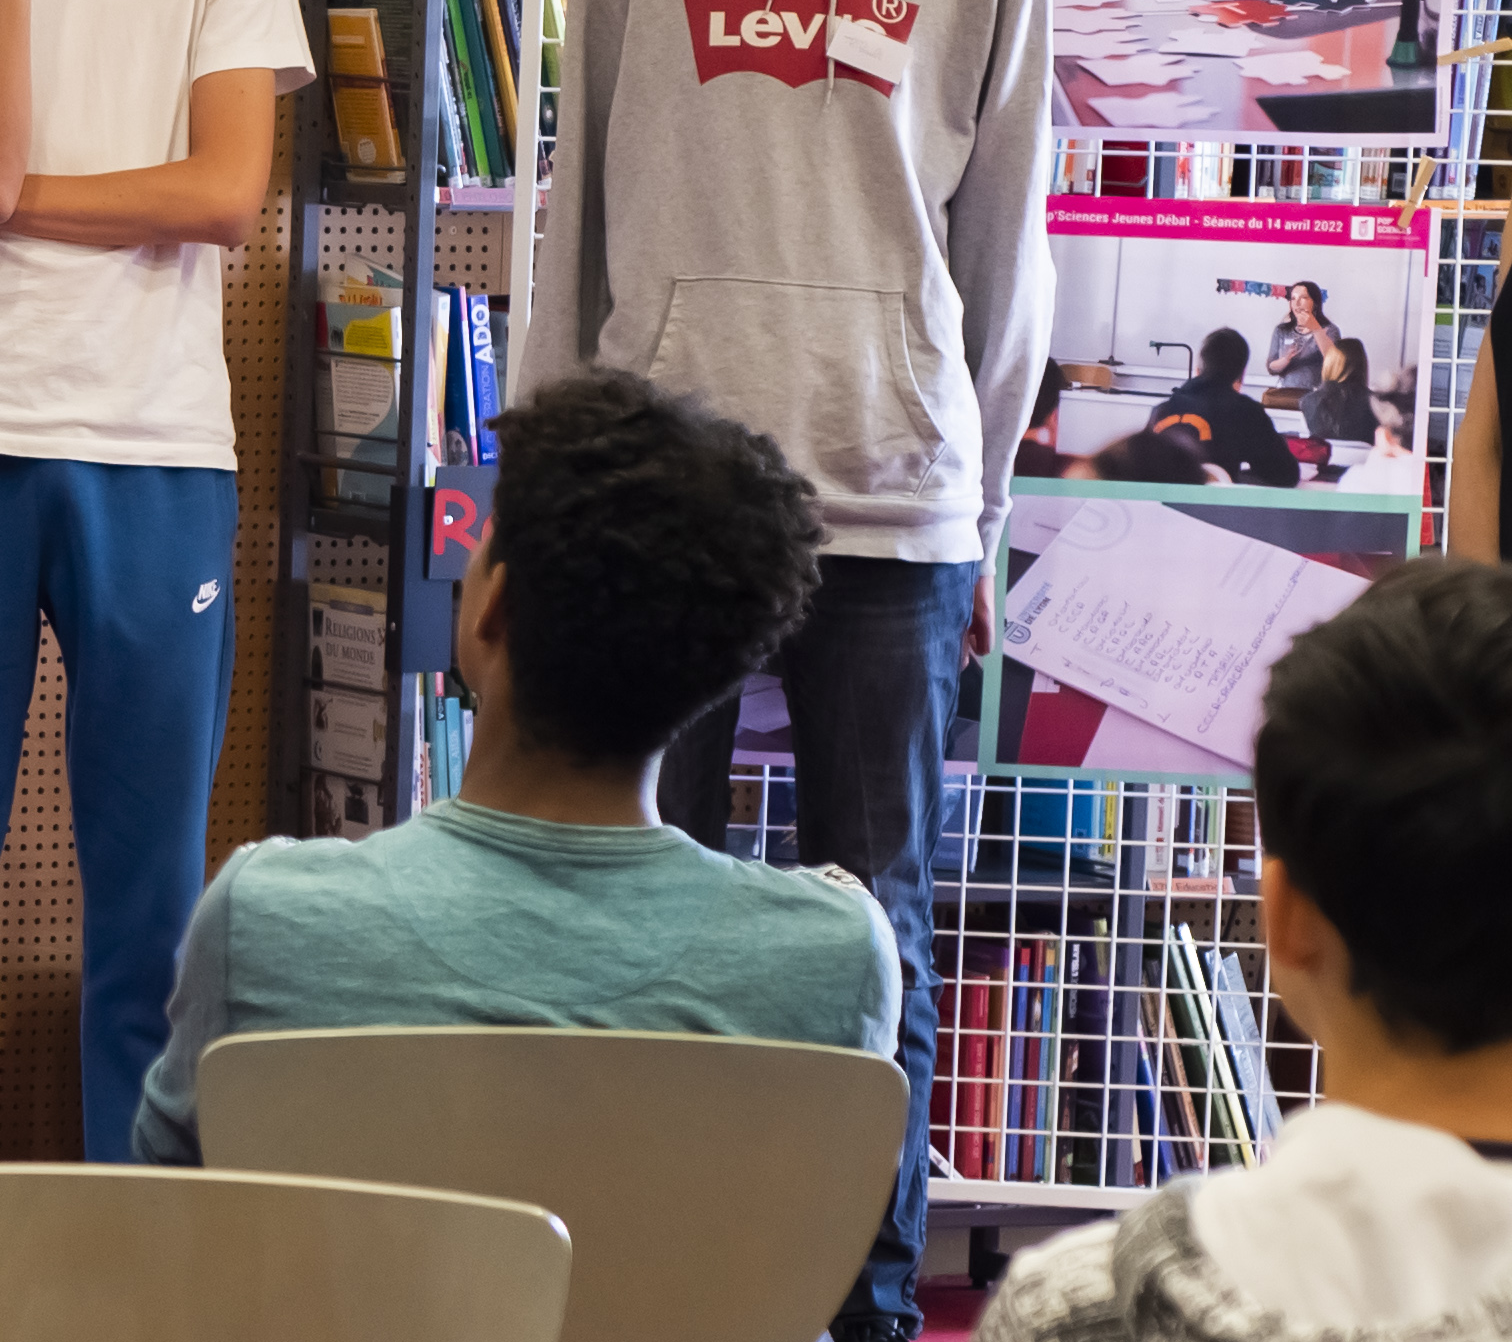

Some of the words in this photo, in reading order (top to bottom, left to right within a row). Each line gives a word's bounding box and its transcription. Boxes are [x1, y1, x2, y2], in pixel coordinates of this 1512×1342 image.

[1112, 212, 1154, 225] Jeunes
[1156, 212, 1191, 227] Débat
[1203, 214, 1246, 229] Séance
[1249, 216, 1263, 229] du
[1266, 217, 1282, 230] 14
[1284, 217, 1311, 232] avril
[1313, 219, 1344, 233] 2022
[470, 303, 495, 364] ADO
[325, 616, 377, 645] RELIGIONS
[325, 643, 340, 658] DU
[341, 645, 376, 665] MONDE
